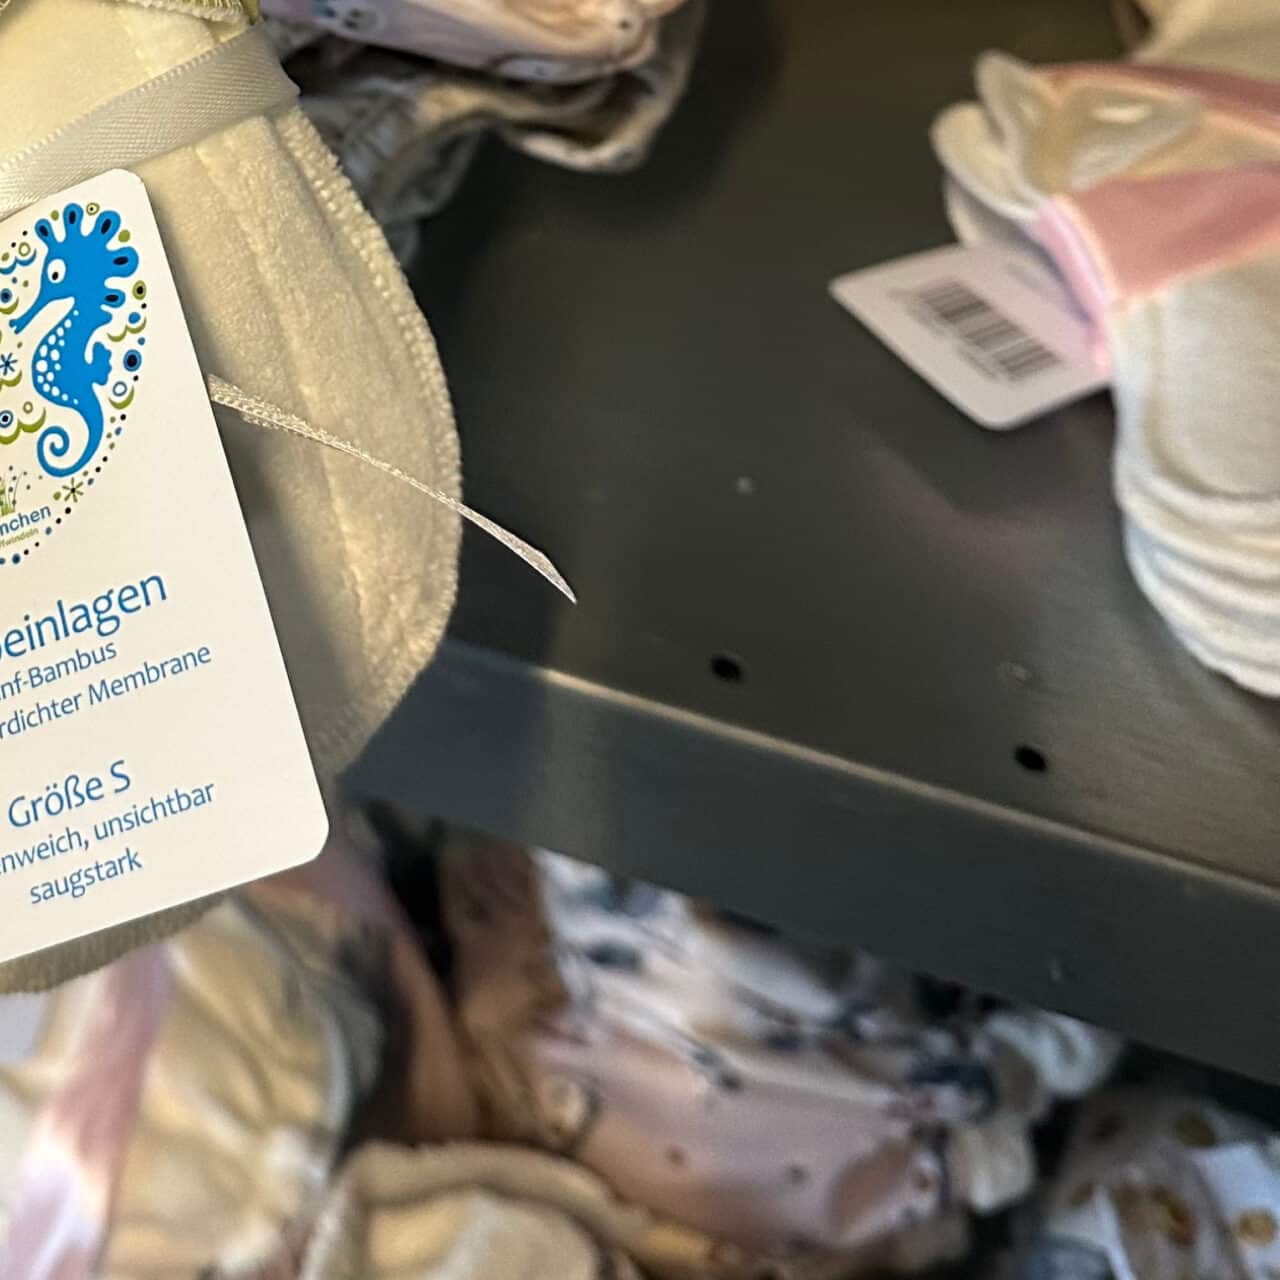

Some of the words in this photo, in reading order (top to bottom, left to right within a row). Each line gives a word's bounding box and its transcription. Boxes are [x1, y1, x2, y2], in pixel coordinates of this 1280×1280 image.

[87, 646, 211, 705] Membrane
[7, 774, 105, 828] Größe
[109, 759, 131, 794] S
[93, 783, 213, 842] unsichtbar
[30, 847, 143, 905] saugstark
